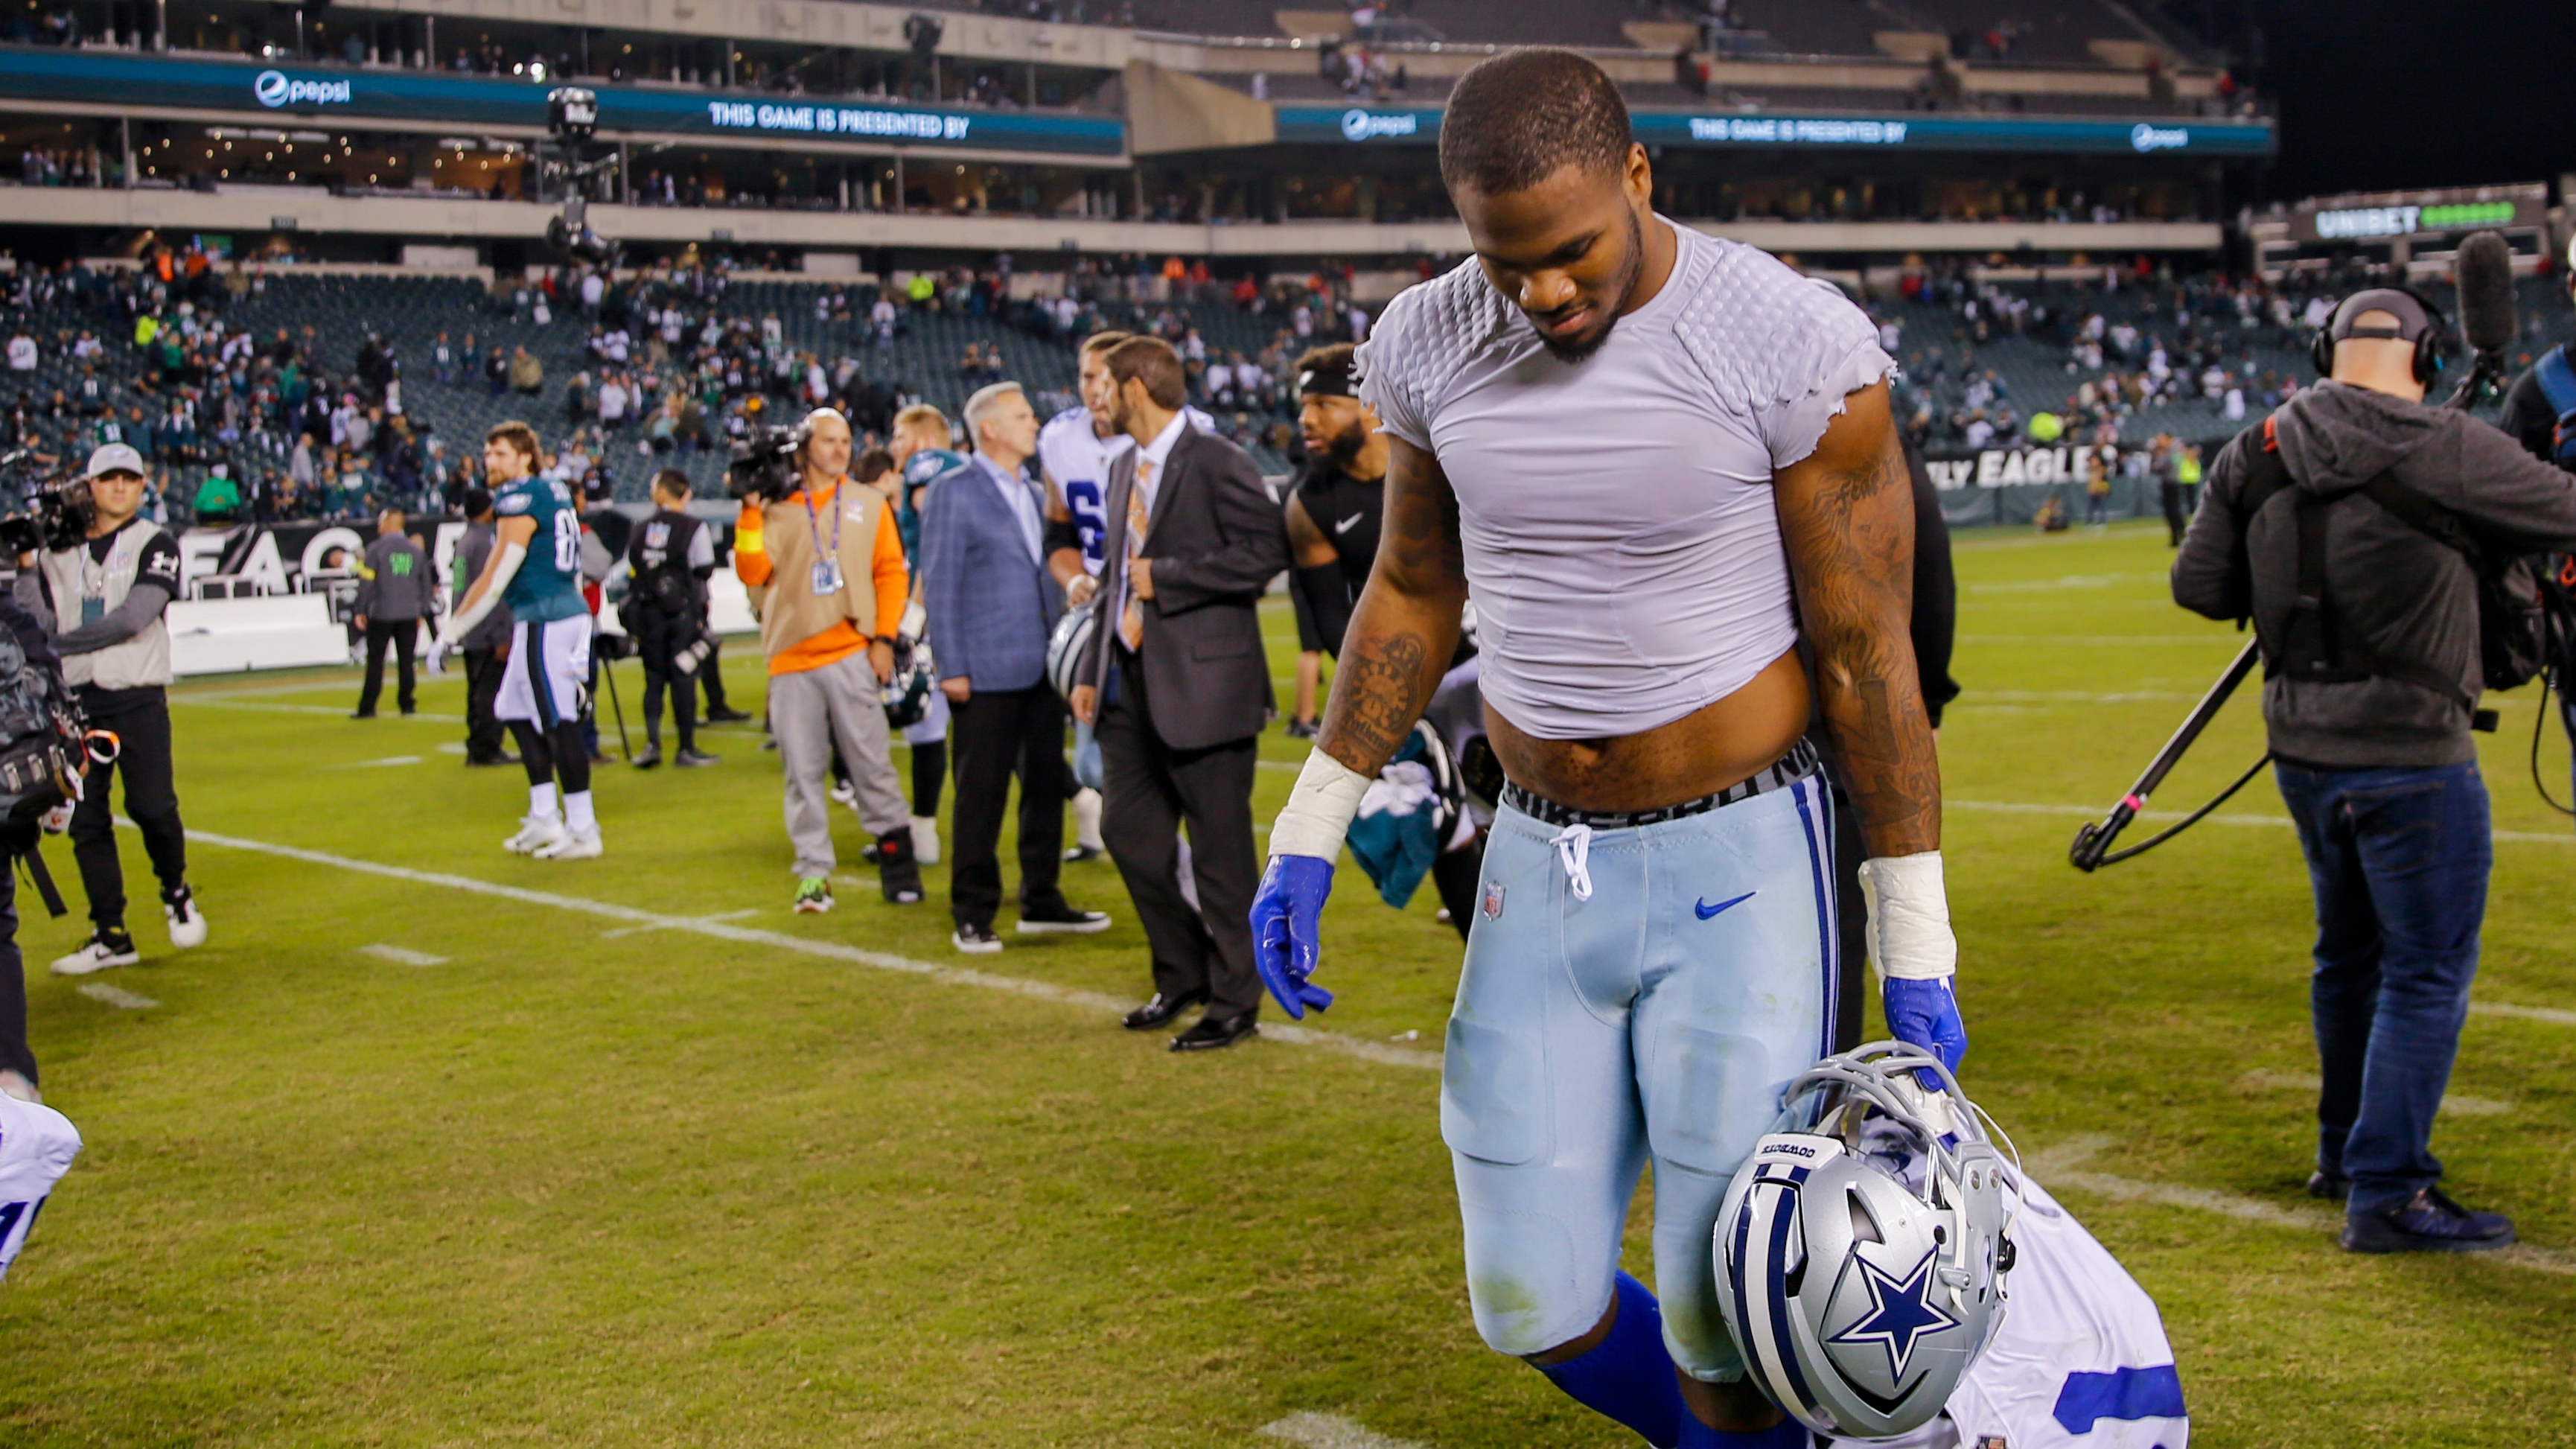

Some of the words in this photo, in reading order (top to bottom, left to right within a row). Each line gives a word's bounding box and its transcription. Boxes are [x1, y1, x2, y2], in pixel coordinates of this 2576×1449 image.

[289, 79, 350, 106] pepsi
[708, 102, 755, 127] THIS
[757, 105, 814, 130] GAME
[816, 108, 836, 132] IS
[838, 109, 943, 138] PRESENTED
[943, 115, 969, 139] BY
[1689, 118, 1729, 140] THIS
[1796, 121, 1884, 144] PRESENTED
[2316, 206, 2420, 239] UNIBET
[1976, 445, 2115, 489] EAGLE
[1761, 1144, 1816, 1158] COWBOYS
